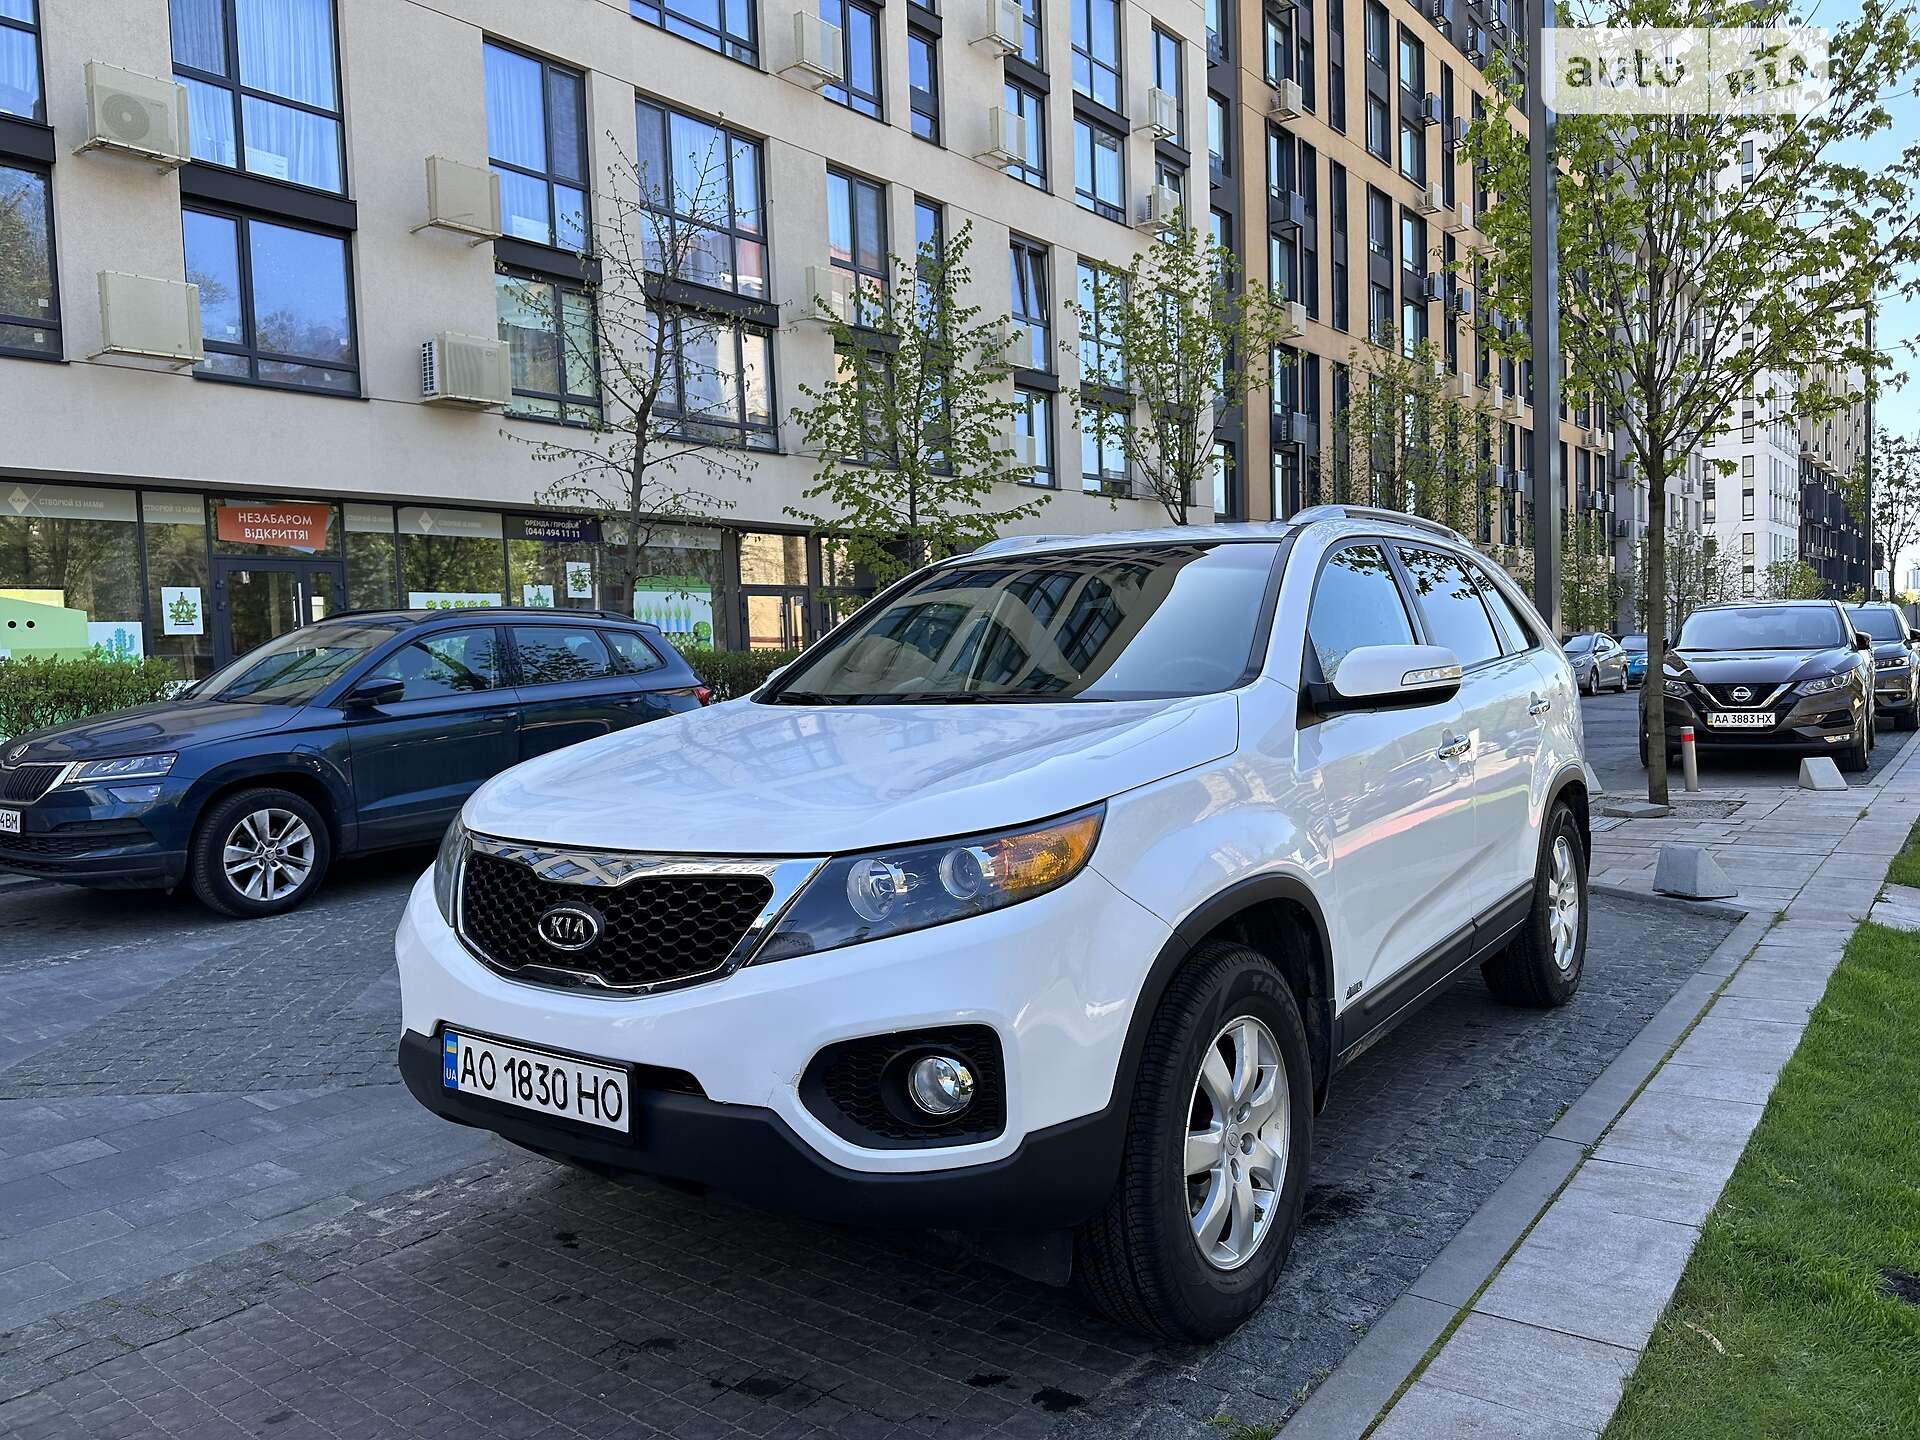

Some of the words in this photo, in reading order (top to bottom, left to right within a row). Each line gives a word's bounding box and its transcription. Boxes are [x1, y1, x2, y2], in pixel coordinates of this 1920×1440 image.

[238, 512, 313, 525] НЕЗАБАРОМ
[525, 527, 545, 536] (044)
[546, 529, 560, 537] 494
[561, 529, 570, 538] 11
[571, 530, 580, 538] 11
[1714, 714, 1729, 724] AA
[1731, 714, 1755, 724] 3883
[1757, 714, 1772, 724] HX
[550, 916, 586, 941] KIA
[445, 1068, 457, 1082] UA
[460, 1045, 497, 1091] AO
[503, 1056, 568, 1111] 1830
[576, 1071, 623, 1122] HO
